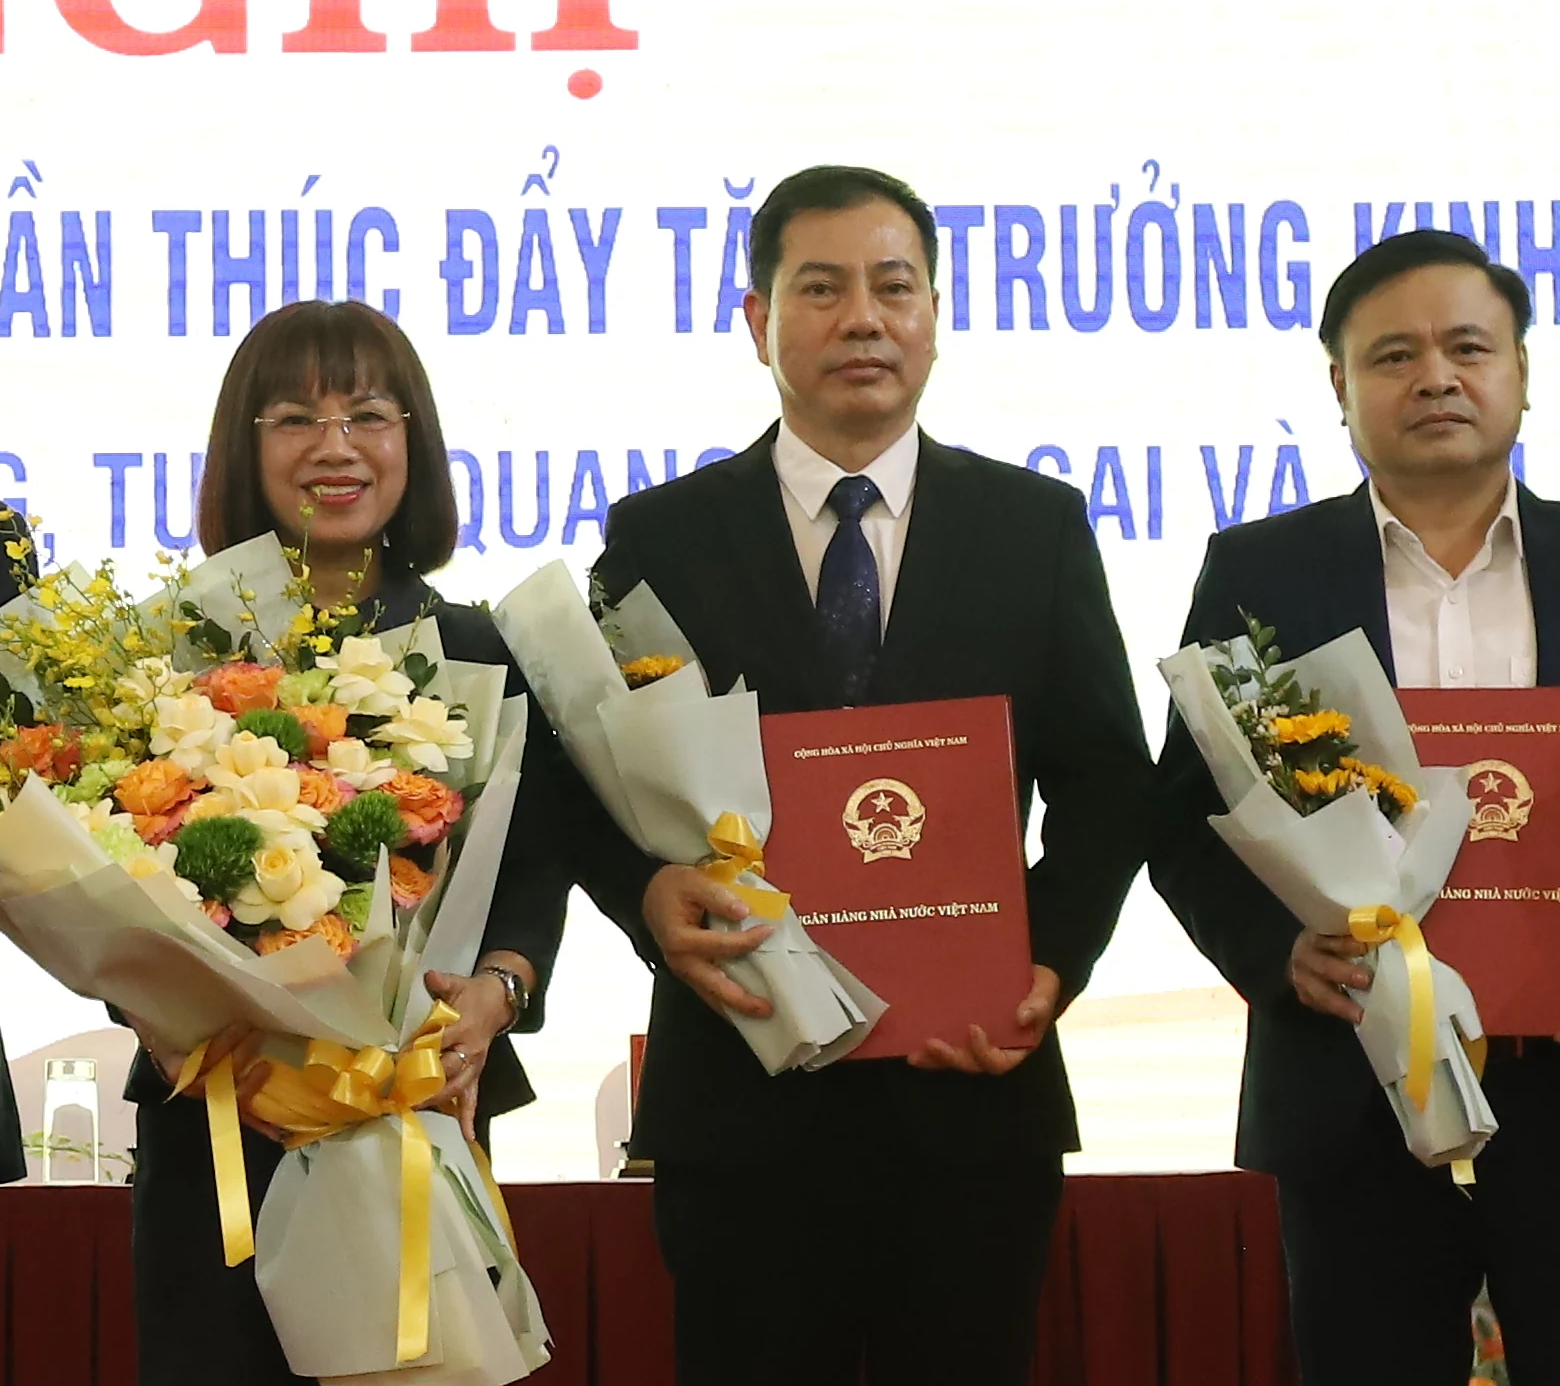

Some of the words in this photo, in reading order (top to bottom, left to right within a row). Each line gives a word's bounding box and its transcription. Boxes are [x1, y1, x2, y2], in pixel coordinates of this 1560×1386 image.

[152, 175, 401, 337] THÚC
[439, 145, 623, 335] ĐẨY
[933, 158, 1312, 334] TRƯỞNG
[1199, 418, 1312, 533] VÀ
[1536, 723, 1557, 734] VIỆT
[794, 748, 820, 759] CỘNG
[855, 742, 872, 755] HỘI
[925, 737, 945, 748] VIỆT
[946, 736, 968, 745] NAM
[1474, 886, 1501, 900] NHÀ
[1504, 887, 1540, 901] NƯỚC
[831, 909, 867, 924] HÀNG
[869, 907, 897, 921] NHÀ
[899, 905, 936, 919] NƯỚC
[937, 902, 968, 917] VIỆT
[969, 902, 999, 913] NAM
